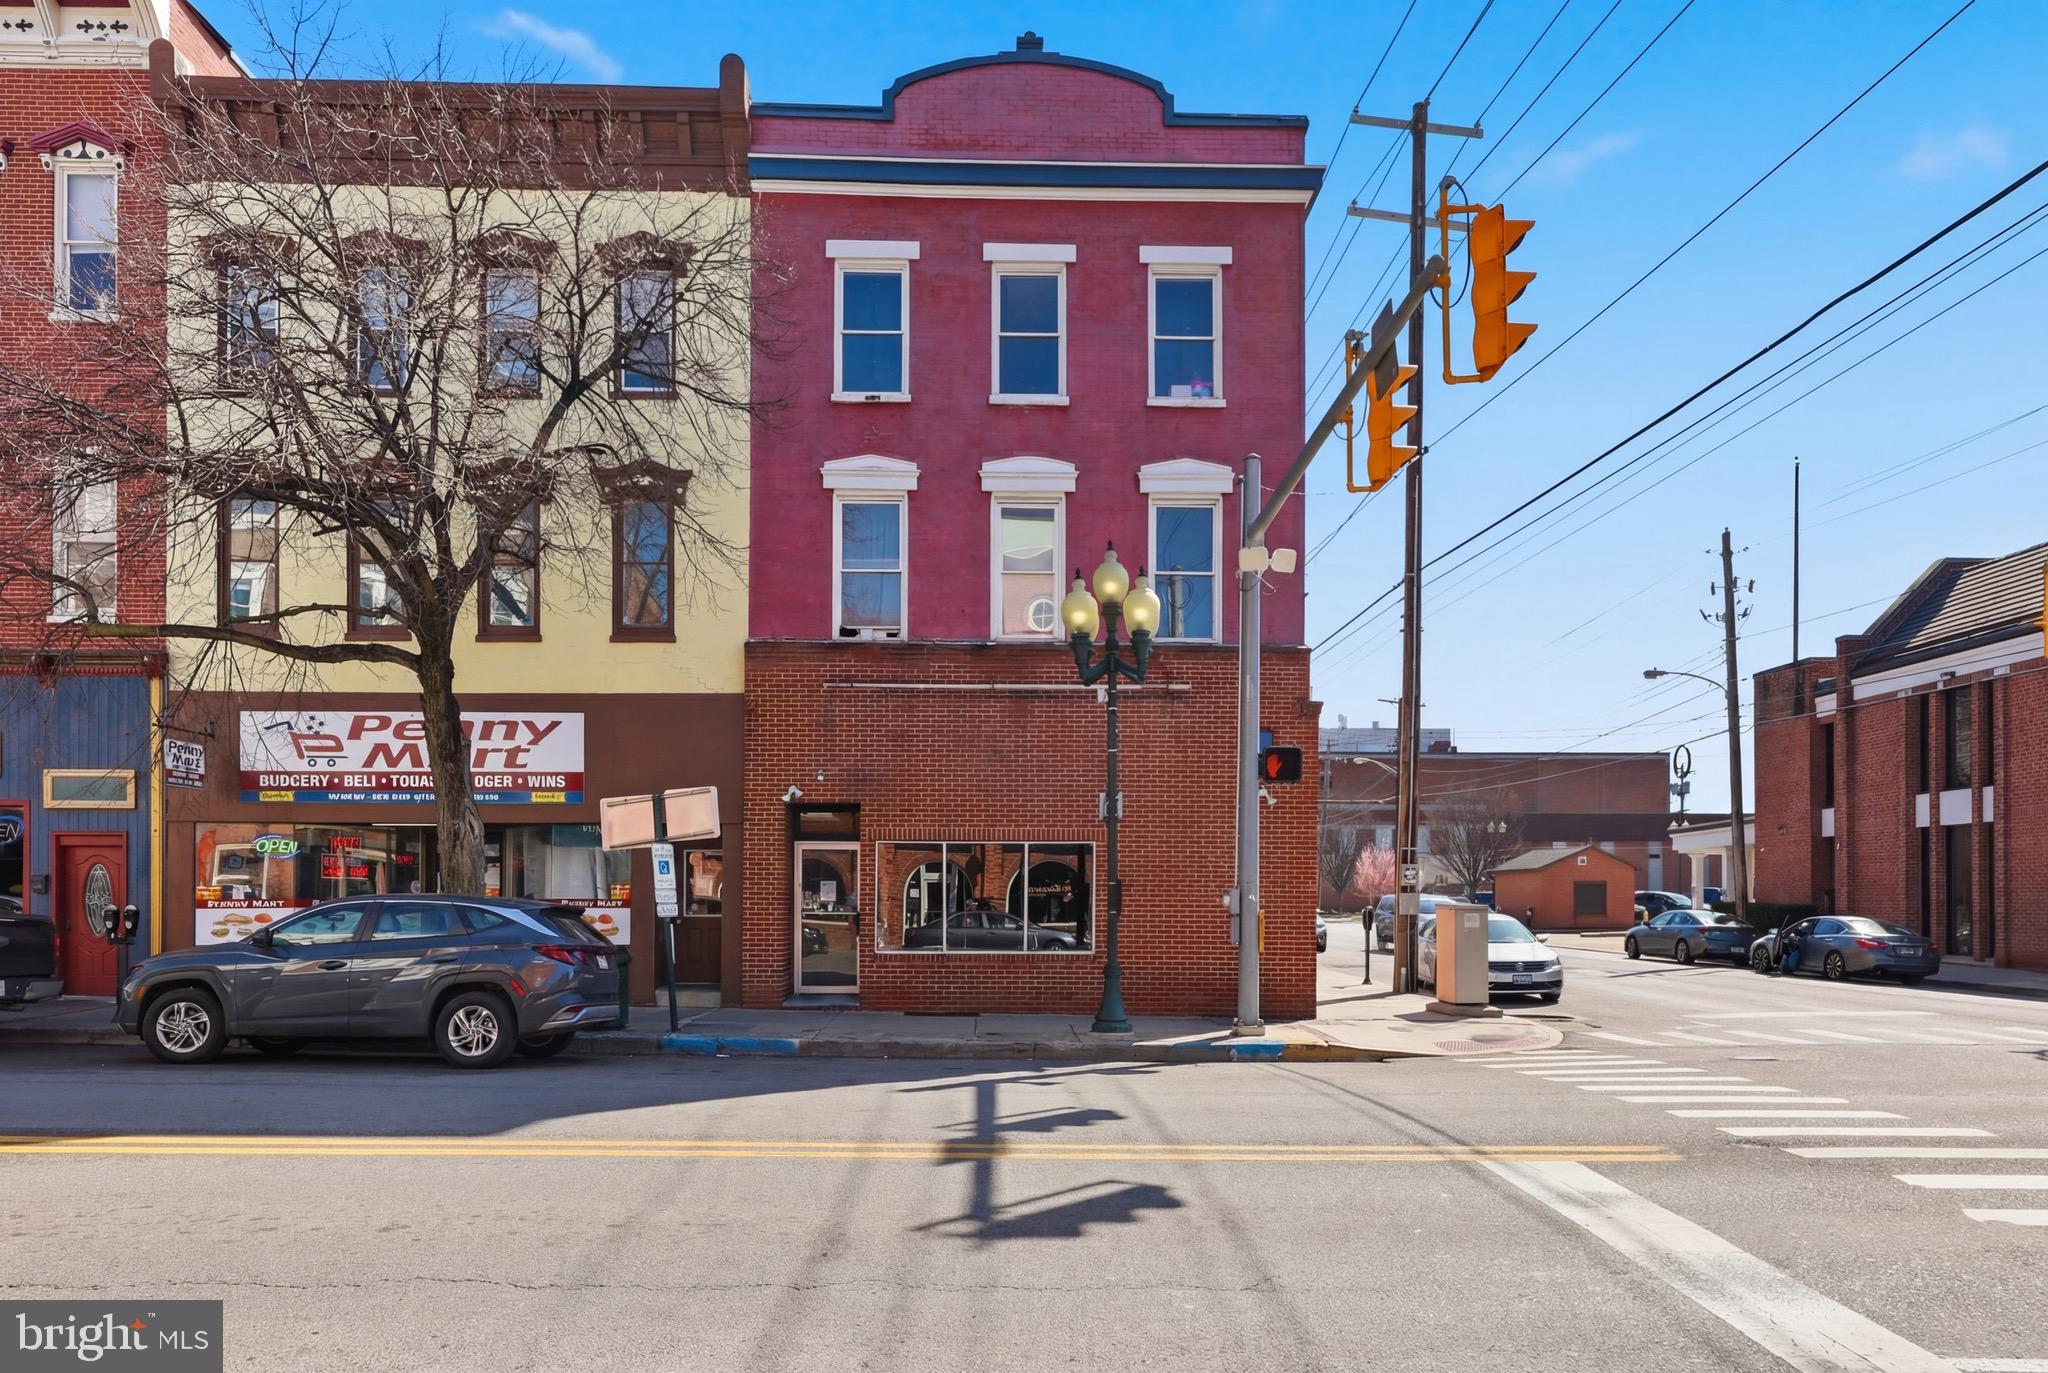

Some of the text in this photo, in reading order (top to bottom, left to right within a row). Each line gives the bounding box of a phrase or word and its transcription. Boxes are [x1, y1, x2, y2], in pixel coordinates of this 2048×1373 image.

[168, 741, 203, 757] Penny
[361, 743, 531, 769] Mrt
[344, 774, 376, 787] BELI
[527, 775, 566, 788] WINS
[256, 839, 298, 854] OPEN
